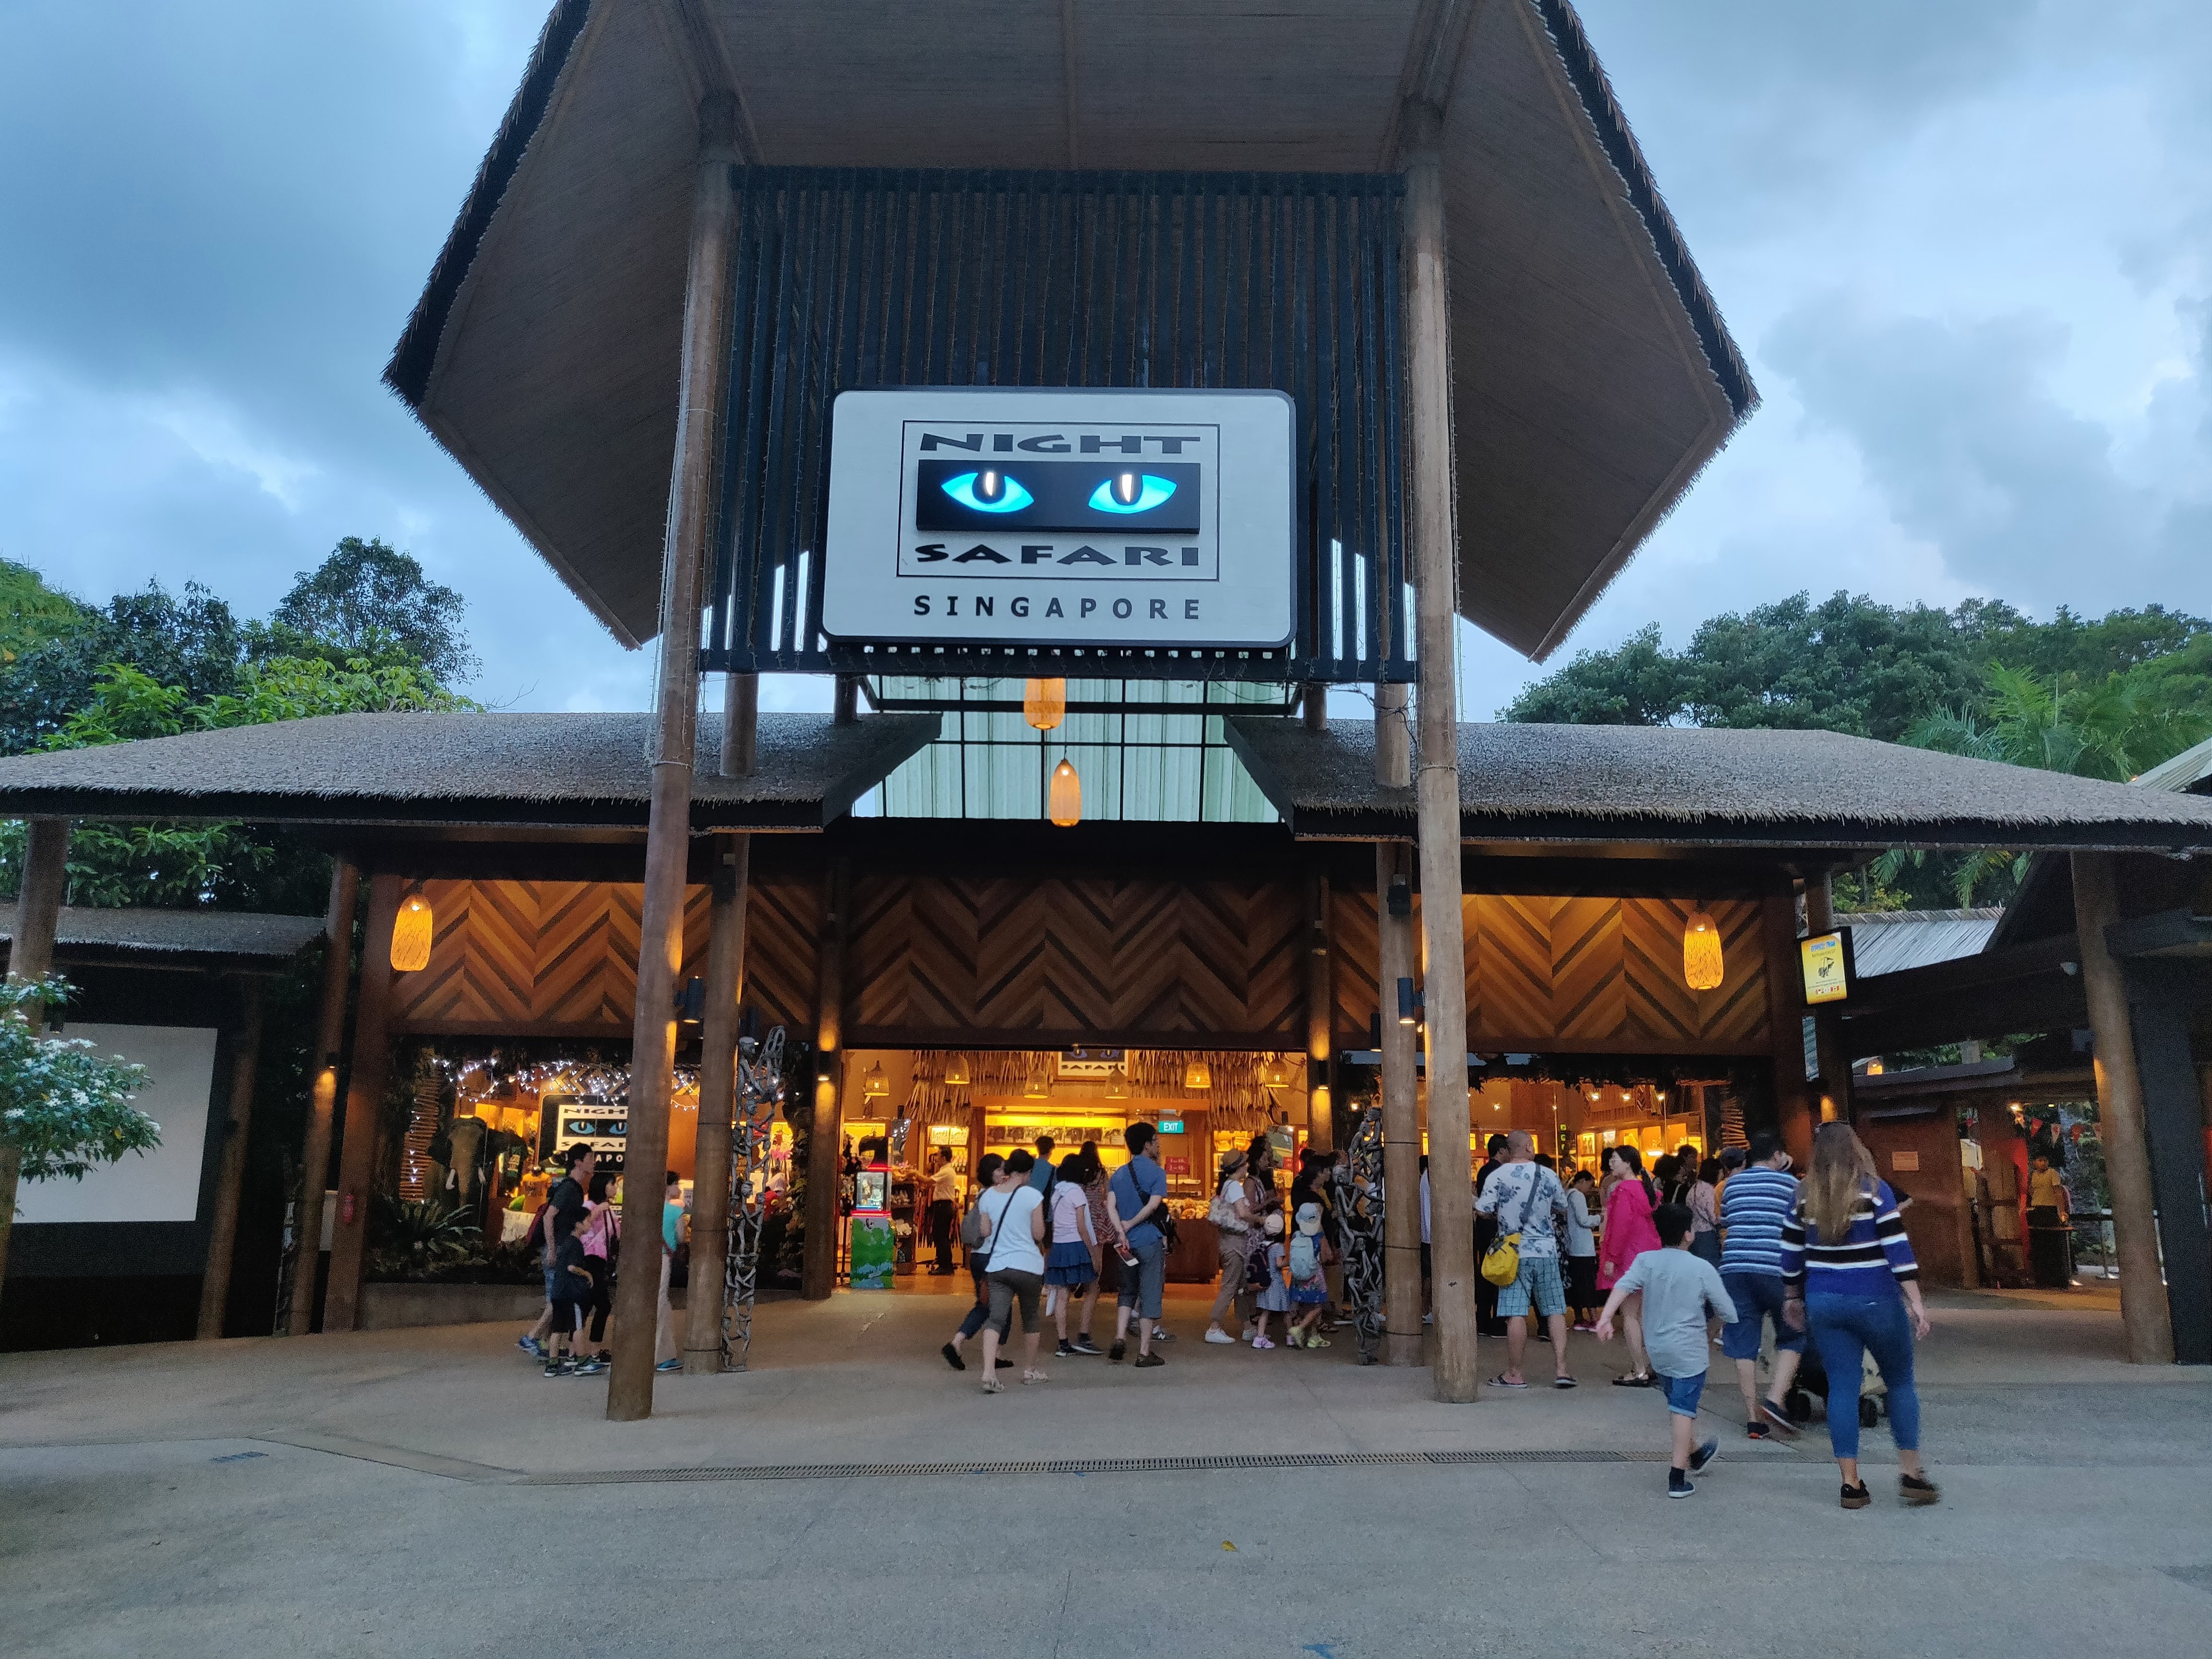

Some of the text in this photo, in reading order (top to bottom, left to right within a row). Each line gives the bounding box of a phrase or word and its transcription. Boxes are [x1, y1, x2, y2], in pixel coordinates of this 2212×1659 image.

[919, 433, 1201, 454] NIGHT
[914, 543, 1200, 566] SAFARI
[914, 595, 1200, 620] SINGAPORE
[1163, 1122, 1178, 1131] EXIT
